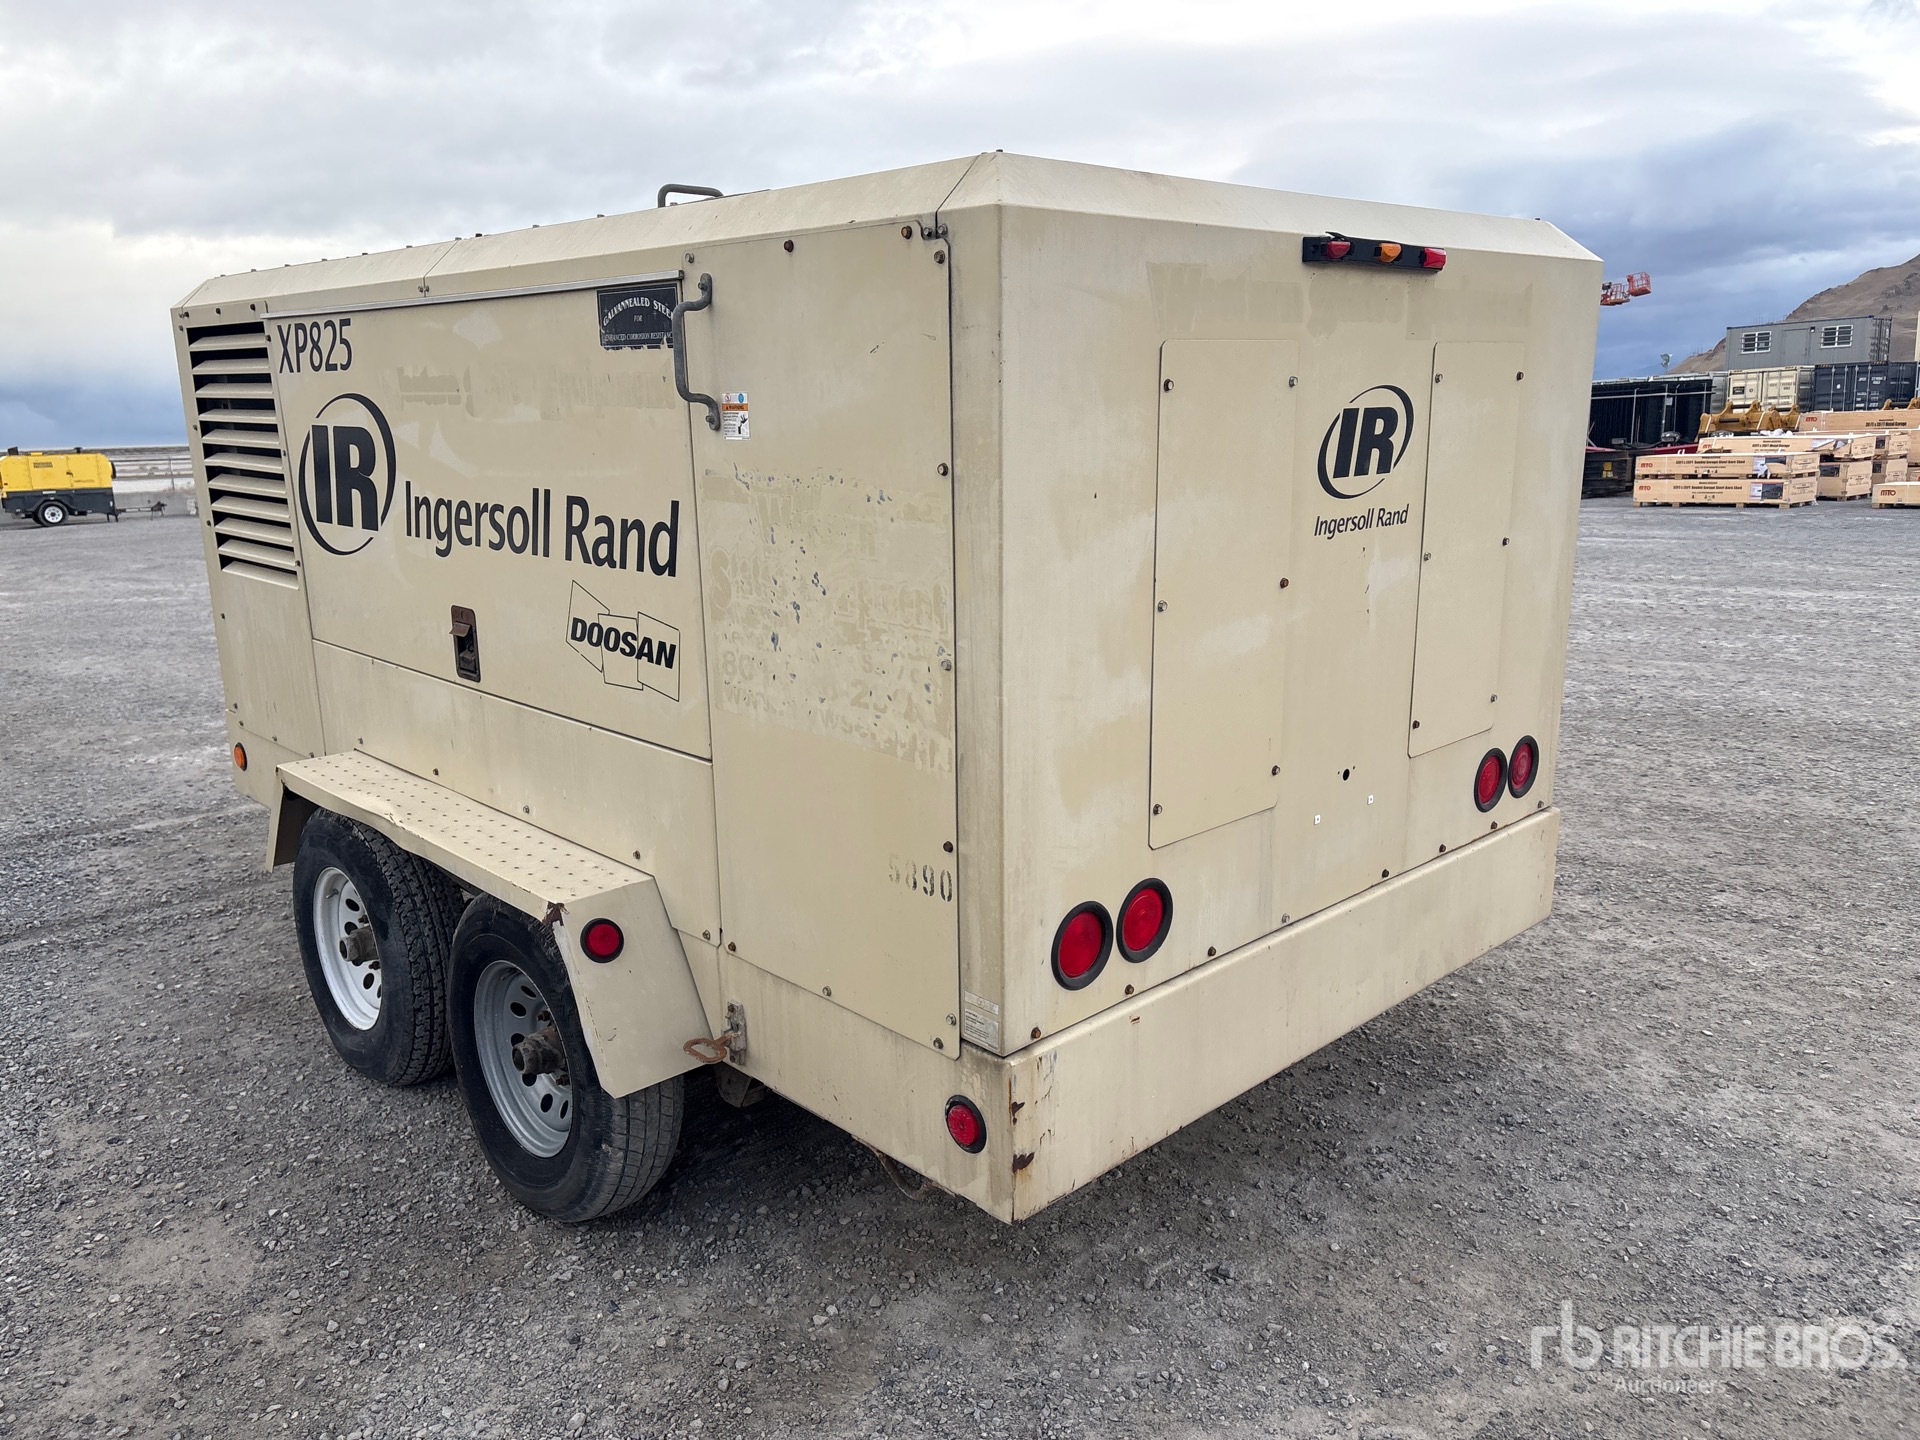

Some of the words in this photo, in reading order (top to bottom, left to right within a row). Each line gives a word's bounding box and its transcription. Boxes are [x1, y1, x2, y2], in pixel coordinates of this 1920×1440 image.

[277, 318, 353, 374] XP825
[1333, 407, 1398, 478] IR
[311, 425, 379, 532] IR
[404, 480, 551, 559] Ingersoll
[564, 494, 681, 578] Rand
[1314, 508, 1375, 539] Ingersoll
[1376, 503, 1409, 528] Rand
[570, 616, 677, 670] DOOSAN
